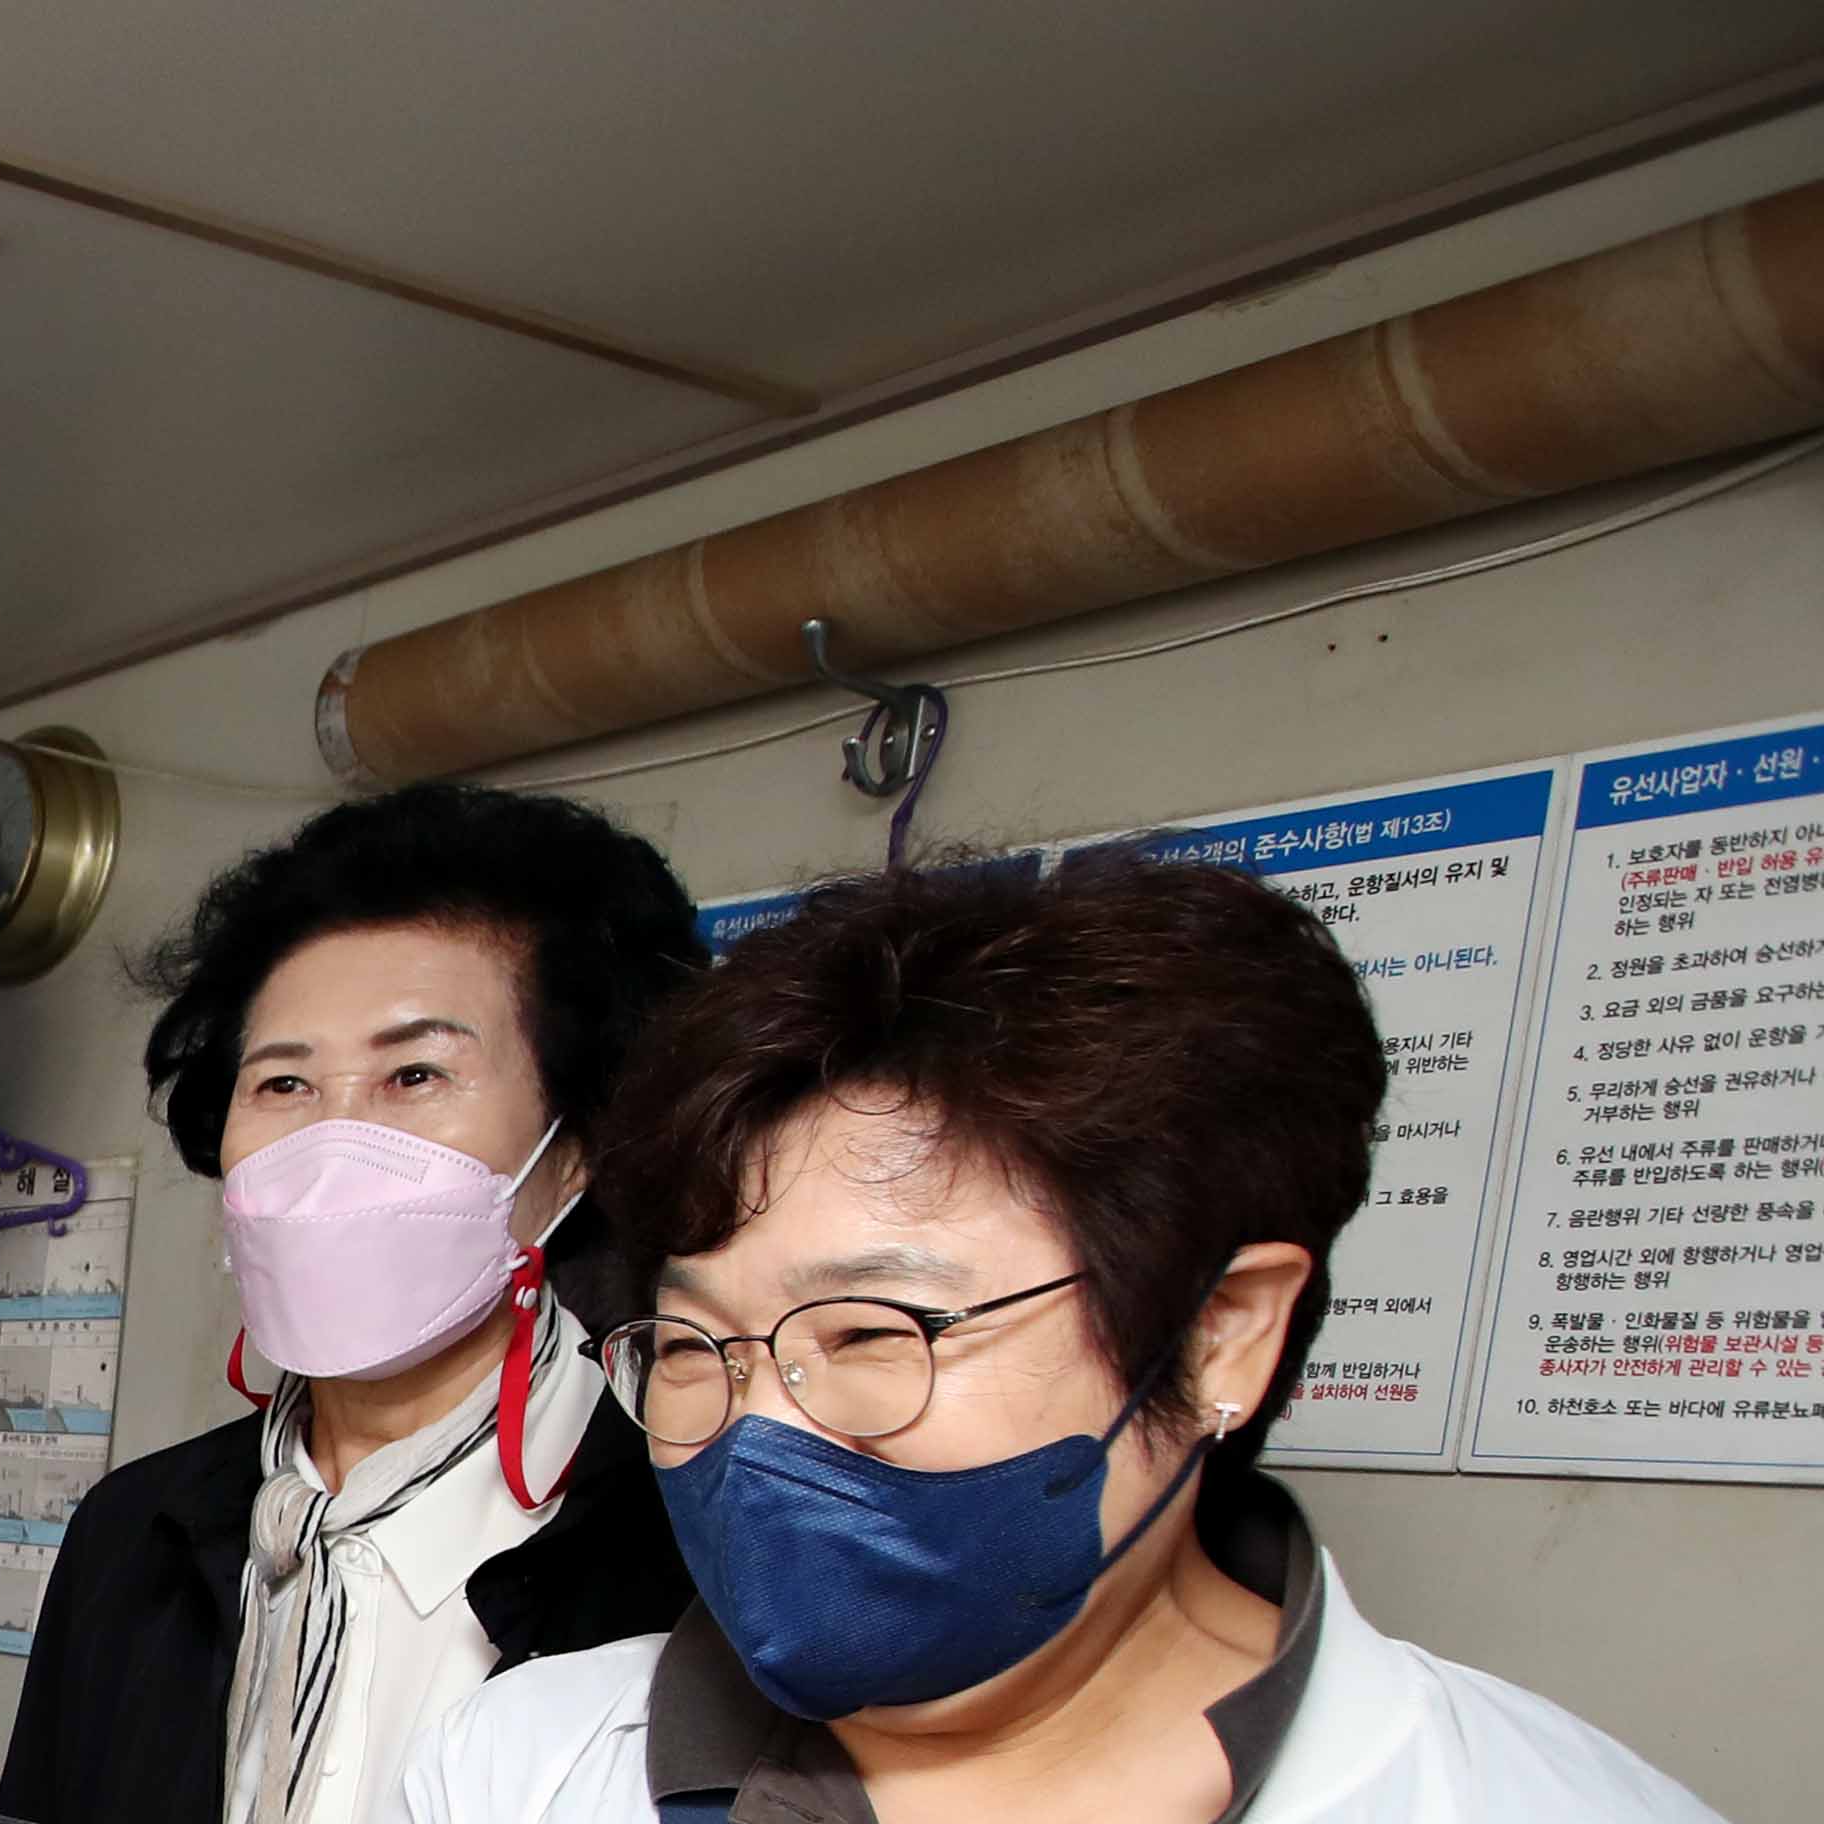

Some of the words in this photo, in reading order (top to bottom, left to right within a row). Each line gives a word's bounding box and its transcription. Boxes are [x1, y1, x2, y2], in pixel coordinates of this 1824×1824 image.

[1609, 760, 1728, 806] 유선사업자
[1753, 746, 1804, 784] 선원
[1253, 820, 1375, 861] 준수사항(법
[1380, 808, 1452, 841] 제13조)
[1627, 839, 1702, 867] 보호자를
[1709, 826, 1789, 856] 동반하지
[1347, 866, 1438, 897] 운항질서의
[1444, 859, 1484, 886] 유지
[1490, 855, 1510, 877] 및
[1716, 856, 1754, 880] 반입
[1618, 889, 1688, 916] 인정되는
[1718, 881, 1755, 902] 또는
[1614, 917, 1650, 937] 하는
[1657, 912, 1695, 934] 행위
[1414, 945, 1499, 974] 아니된다.
[1586, 964, 1602, 981] 2.
[1610, 955, 1665, 980] 정원을
[1671, 946, 1748, 973] 초과하여
[1579, 1005, 1595, 1022] 3.
[1602, 999, 1640, 1020] 요금
[1646, 994, 1684, 1015] 외의
[1690, 987, 1748, 1012] 금품을
[1440, 1031, 1473, 1050] 기타
[1572, 1046, 1588, 1062] 4.
[1597, 1039, 1652, 1061] 정당한
[1657, 1034, 1696, 1056] 사유
[1703, 1030, 1741, 1052] 없이
[1747, 1024, 1807, 1049] 운항을
[1406, 1054, 1470, 1075] 위반하는
[1566, 1086, 1582, 1103] 5.
[1588, 1078, 1658, 1102] 무리하게
[1663, 1074, 1717, 1097] 승선을
[1724, 1066, 1816, 1092] 권유하거나
[1583, 1103, 1655, 1124] 거부하는
[1662, 1099, 1702, 1120] 행위
[1396, 1119, 1461, 1140] 마시거나
[1556, 1149, 1572, 1166] 6.
[1578, 1145, 1614, 1166] 유선
[1621, 1142, 1674, 1162] 내에서
[1680, 1138, 1735, 1160] 주류를
[1572, 1167, 1626, 1188] 주류를
[1633, 1161, 1727, 1186] 반입하도록
[1733, 1159, 1773, 1180] 하는
[1397, 1186, 1449, 1206] 효용을
[1546, 1212, 1561, 1229] 7.
[1568, 1207, 1641, 1229] 음란행위
[1647, 1205, 1684, 1225] 기타
[1692, 1202, 1749, 1224] 선량한
[1755, 1200, 1815, 1221] 풍속을
[1538, 1251, 1554, 1269] 8.
[1563, 1248, 1633, 1269] 영업시간
[1639, 1247, 1675, 1266] 외에
[1682, 1244, 1777, 1266] 항행하거나
[1555, 1271, 1626, 1292] 항행하는
[1633, 1270, 1670, 1291] 행위
[1383, 1297, 1432, 1314] 외에서
[1528, 1314, 1544, 1331] 9.
[1551, 1311, 1604, 1331] 폭발물
[1624, 1310, 1698, 1331] 인화물질
[1705, 1310, 1725, 1330] 등
[1733, 1309, 1811, 1330] 위험물을
[1543, 1335, 1615, 1354] 운송하는
[1724, 1333, 1799, 1354] 보관시설
[1342, 1361, 1421, 1380] 반입하거나
[1538, 1358, 1606, 1378] 종사자가
[1612, 1358, 1682, 1377] 안전하게
[1688, 1358, 1743, 1377] 관리할
[1749, 1358, 1768, 1377] 수
[1775, 1358, 1812, 1378] 있는
[1311, 1383, 1368, 1401] 설치하여
[1374, 1383, 1419, 1401] 선원등
[1516, 1399, 1539, 1416] 10.
[1547, 1398, 1618, 1417] 하천호소
[1624, 1399, 1661, 1418] 또는
[1668, 1399, 1725, 1419] 바다에
